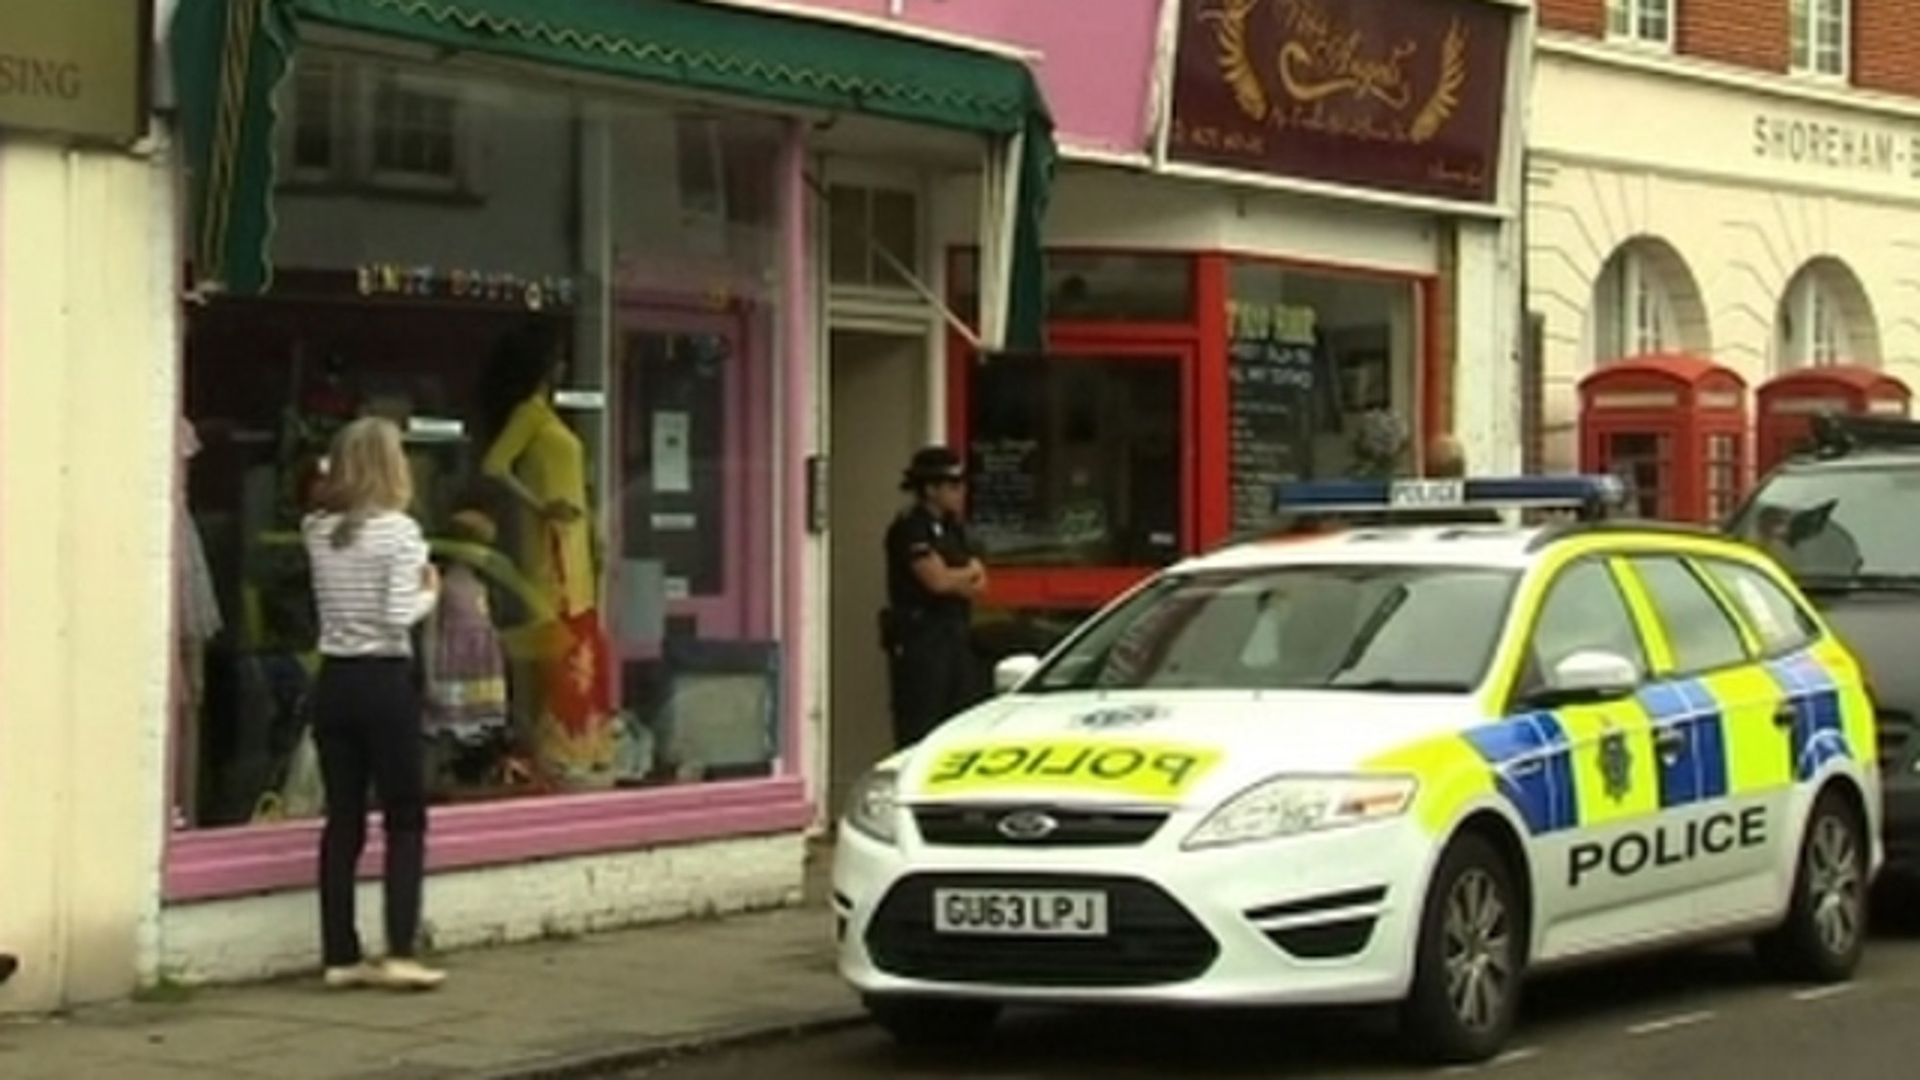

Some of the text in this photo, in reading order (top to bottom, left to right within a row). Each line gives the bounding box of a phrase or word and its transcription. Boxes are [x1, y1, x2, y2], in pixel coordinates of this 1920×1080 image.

[1567, 805, 1767, 888] POLICE
[944, 895, 1096, 931] GU63 LPJ
